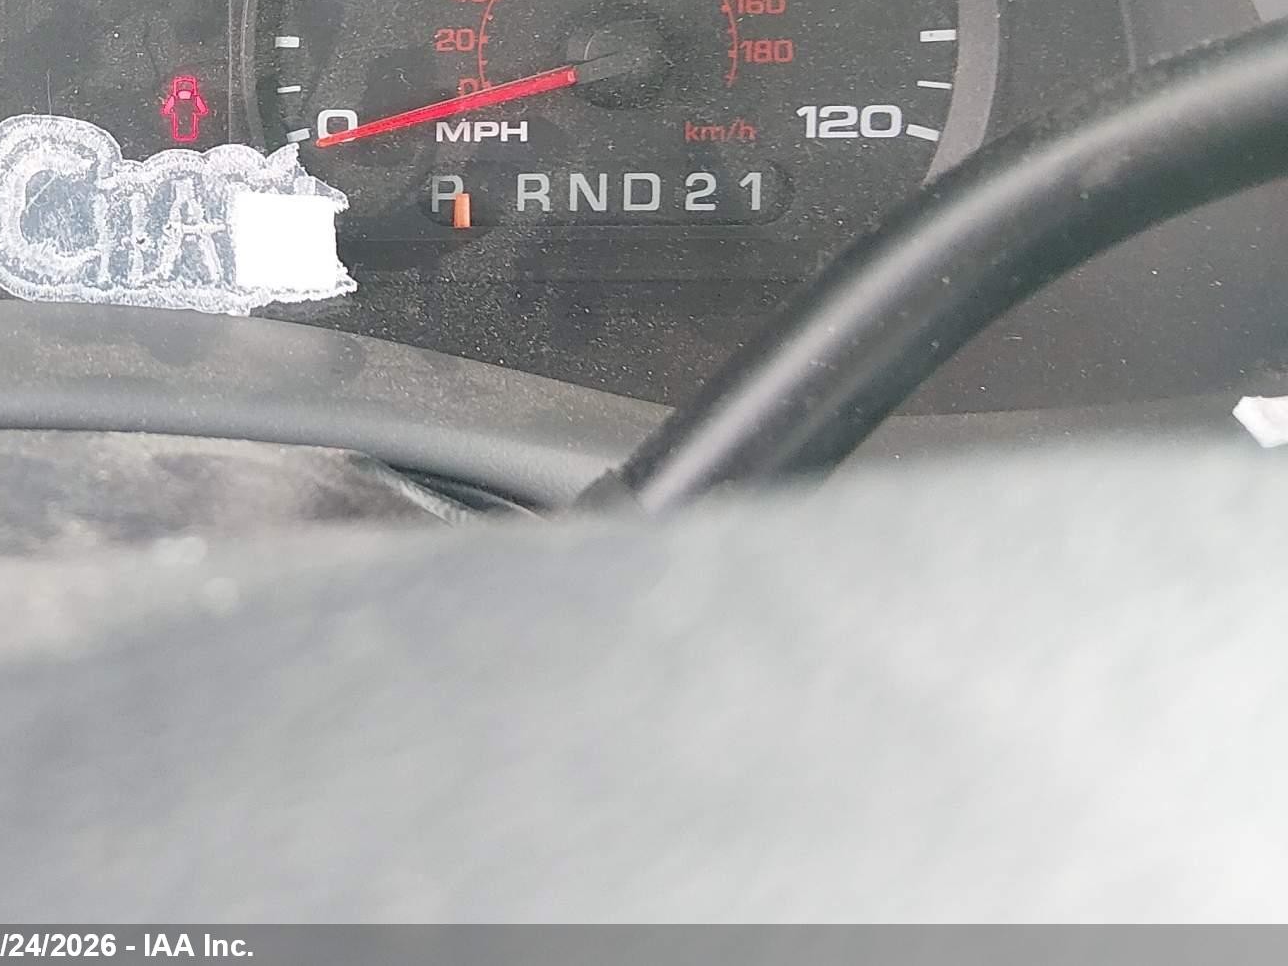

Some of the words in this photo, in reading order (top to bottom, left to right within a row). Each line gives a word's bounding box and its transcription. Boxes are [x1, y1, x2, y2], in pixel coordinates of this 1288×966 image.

[435, 29, 475, 51] 20
[743, 40, 793, 63] 180
[318, 110, 358, 142] 0
[437, 122, 527, 142] MPH
[685, 120, 756, 141] km/h
[797, 105, 902, 138] 120
[432, 175, 464, 212] P
[517, 174, 550, 211] R
[570, 173, 607, 211] N
[624, 173, 660, 210] D
[686, 173, 716, 210] 2
[740, 173, 761, 210] 1
